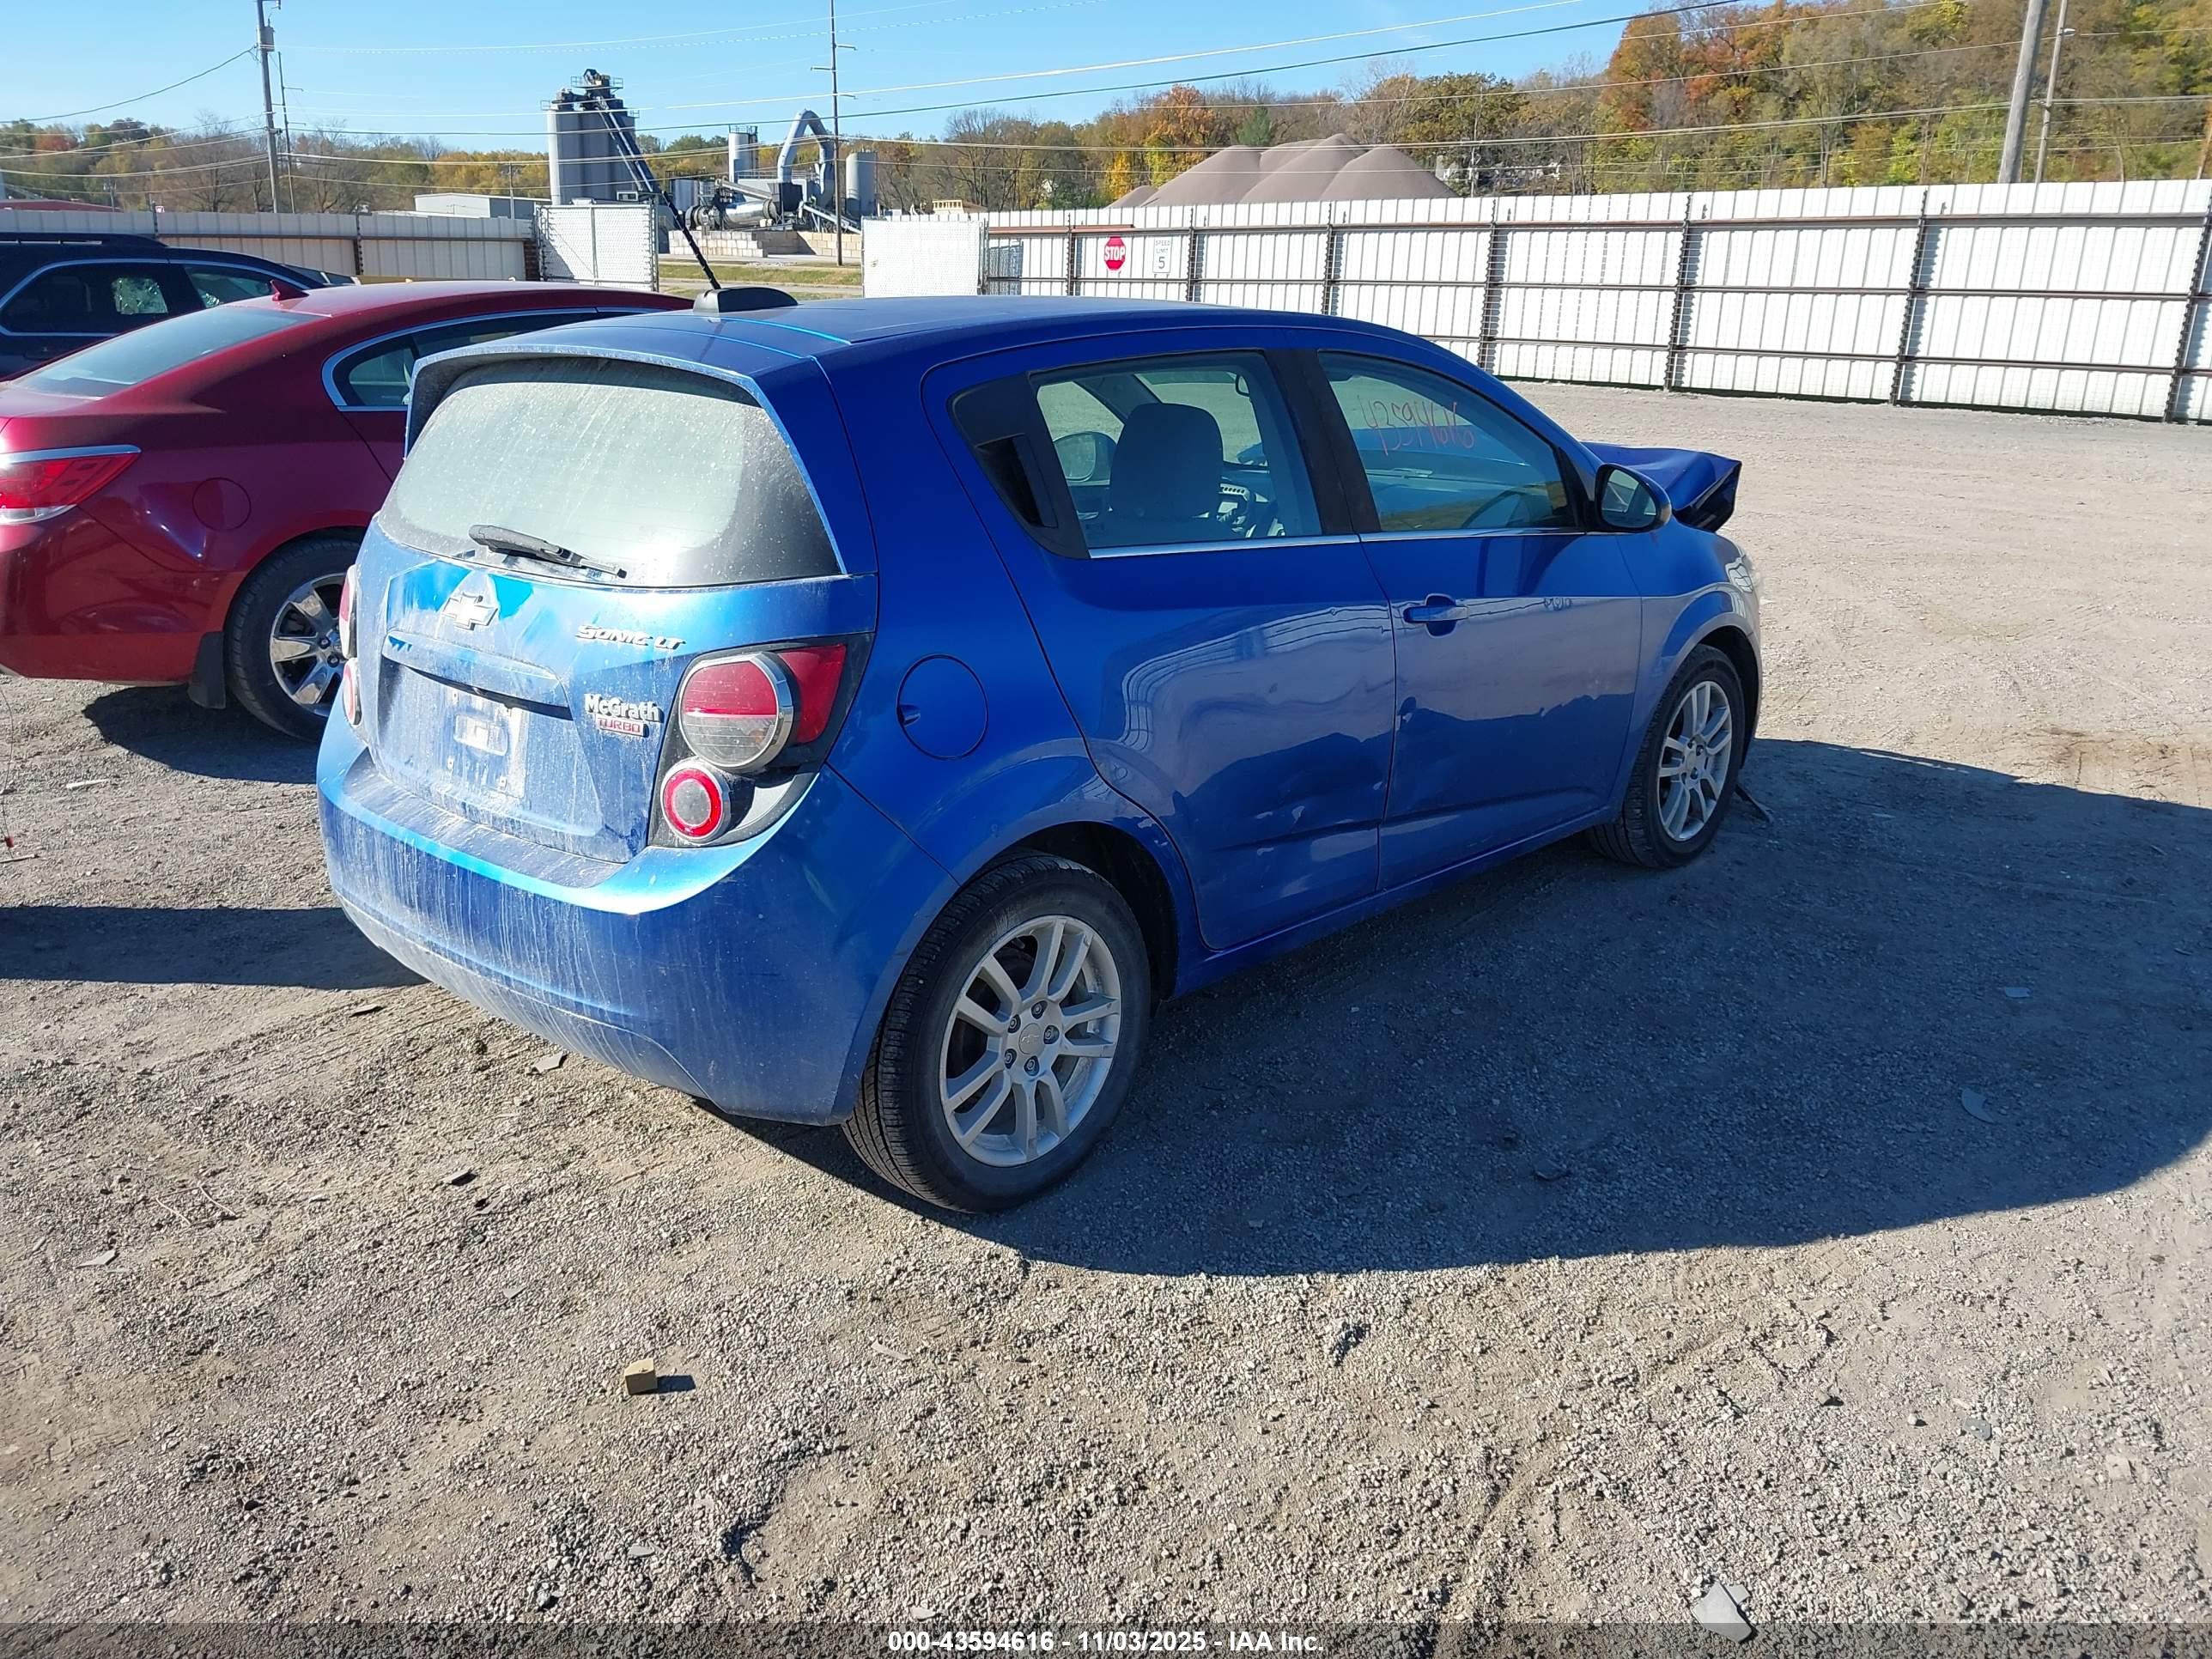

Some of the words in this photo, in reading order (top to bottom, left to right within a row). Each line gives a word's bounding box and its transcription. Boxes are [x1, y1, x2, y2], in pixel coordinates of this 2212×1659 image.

[1104, 246, 1126, 261] STOP
[1158, 256, 1165, 270] 5
[653, 636, 686, 650] LT
[584, 693, 663, 723] McGrath
[597, 718, 641, 733] TURBO
